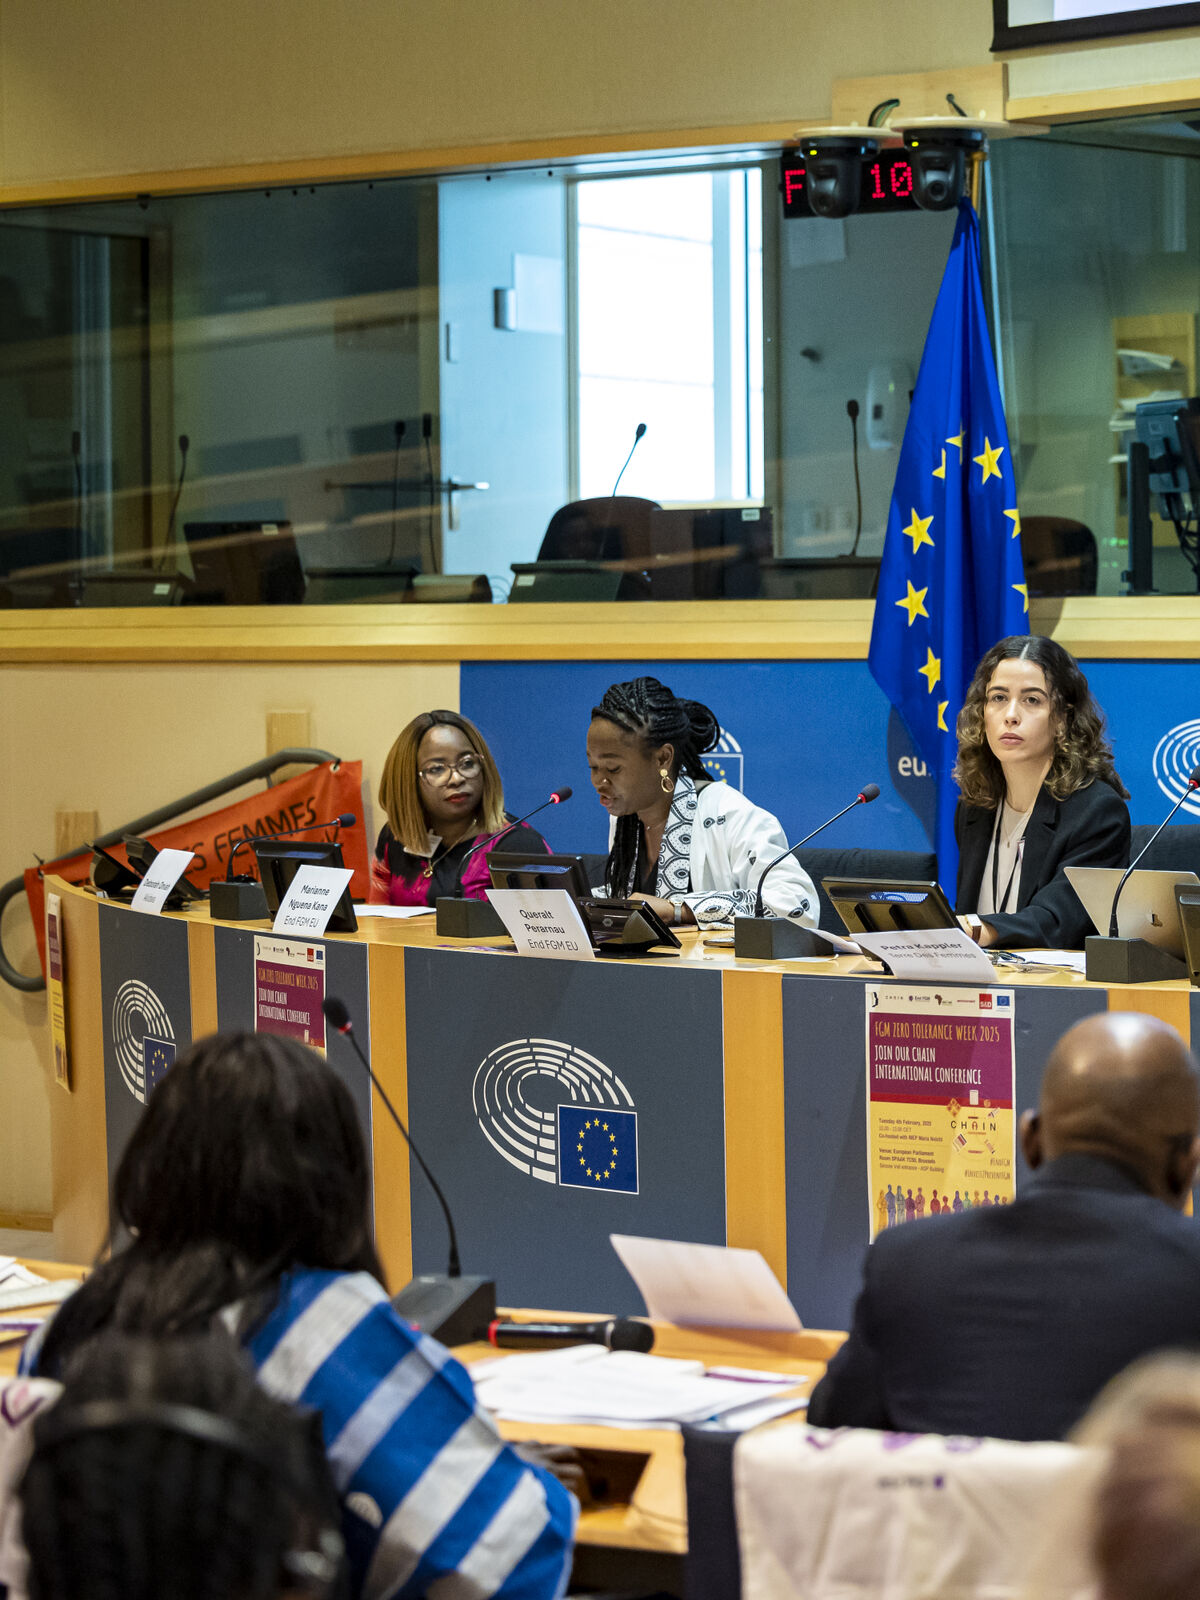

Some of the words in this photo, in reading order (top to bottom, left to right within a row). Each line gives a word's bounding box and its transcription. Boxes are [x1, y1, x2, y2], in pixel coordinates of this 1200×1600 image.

[785, 168, 806, 205] F
[870, 161, 913, 199] 10
[300, 884, 330, 896] Marianne
[311, 901, 328, 911] Kana
[519, 909, 554, 920] Queralt
[284, 915, 297, 926] End
[296, 916, 310, 927] FGM
[309, 917, 320, 928] EU
[524, 923, 565, 934] Perarnau
[527, 938, 545, 949] End
[544, 939, 566, 951] FGM
[565, 941, 579, 951] EU
[879, 943, 914, 951] Petra
[914, 942, 962, 951] Kappler
[874, 1021, 891, 1038] FGM
[892, 1022, 910, 1039] ZERO
[911, 1022, 953, 1041] TOLERANCE
[955, 1025, 978, 1042] WEEK
[979, 1026, 1000, 1043] 2025
[874, 1044, 893, 1062] JOIN
[895, 1046, 911, 1062] OUR
[911, 1046, 936, 1063] CHAIN
[875, 1064, 933, 1082] INTERNATIONAL
[934, 1067, 982, 1085] CONFERENCE
[950, 1120, 996, 1132] CHAIN
